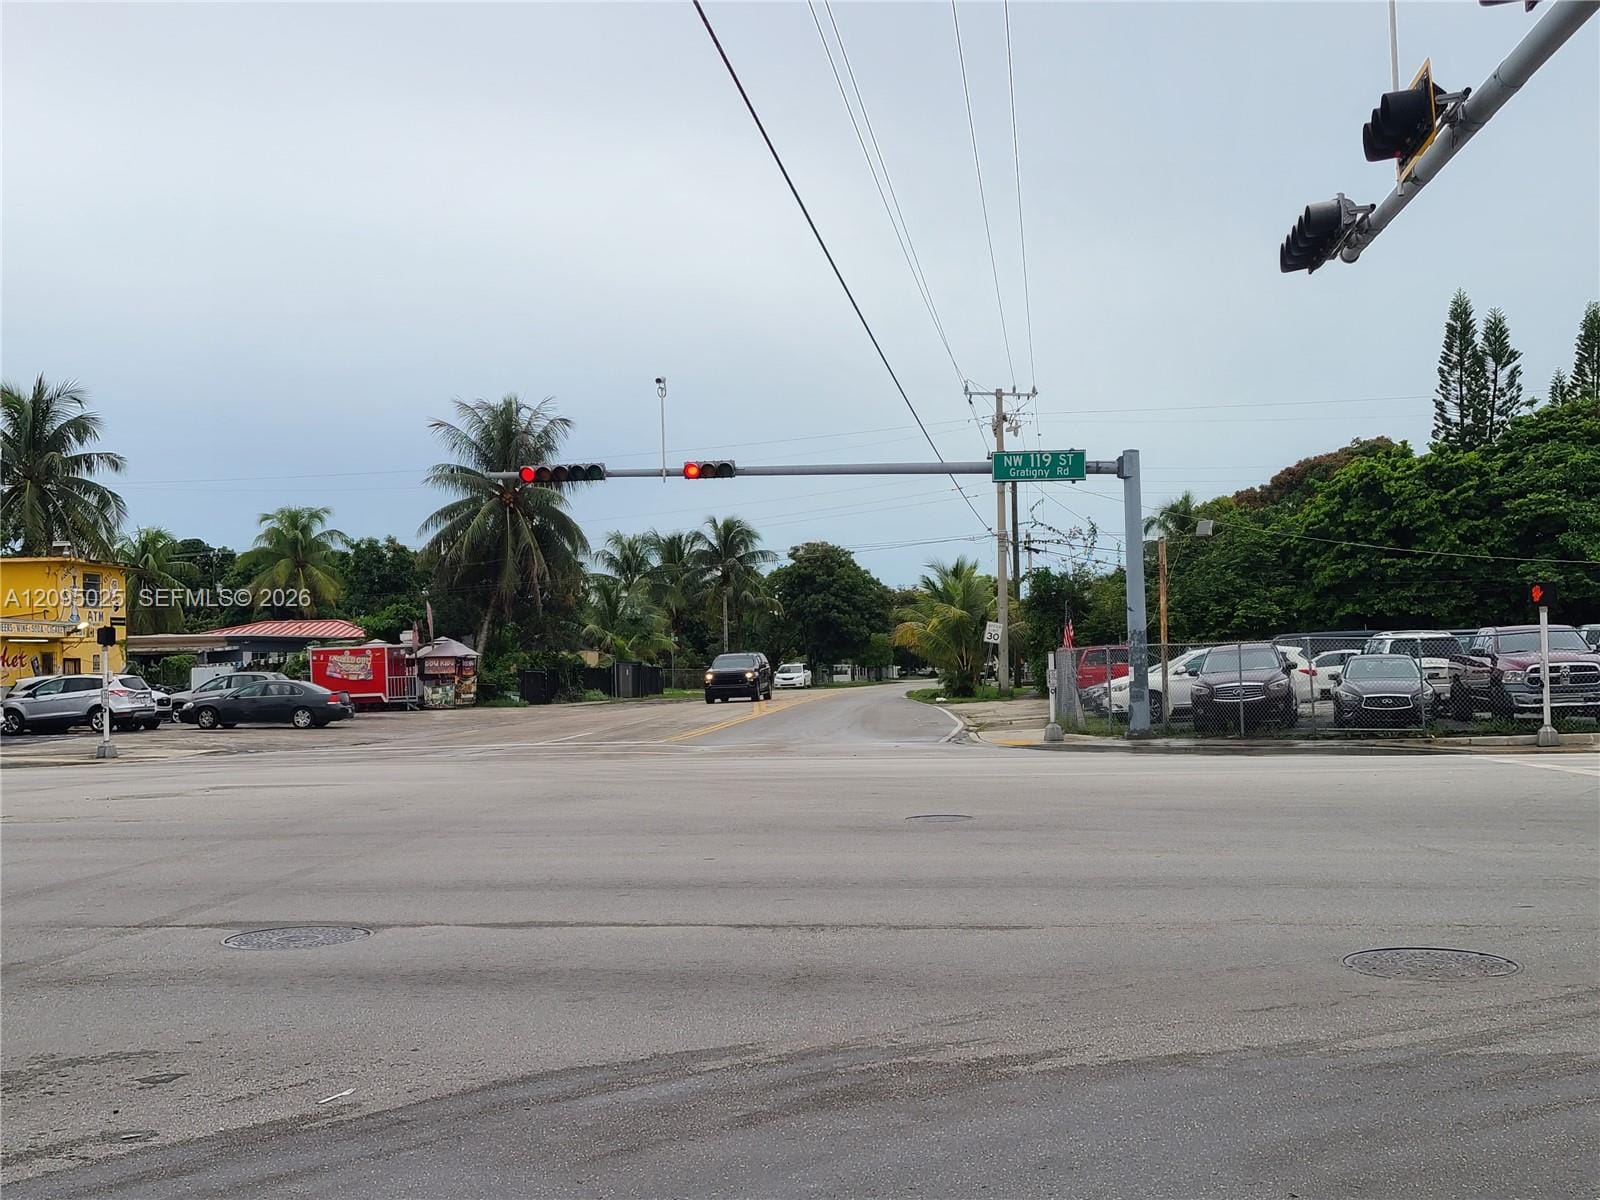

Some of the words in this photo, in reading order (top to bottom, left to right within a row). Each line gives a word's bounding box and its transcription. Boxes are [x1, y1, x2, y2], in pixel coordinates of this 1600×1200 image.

[1003, 455, 1023, 467] NW
[1030, 453, 1052, 468] 119
[1059, 454, 1074, 466] ST
[1009, 467, 1050, 479] Gratigny
[1056, 466, 1069, 476] Rd
[986, 632, 1000, 641] 30
